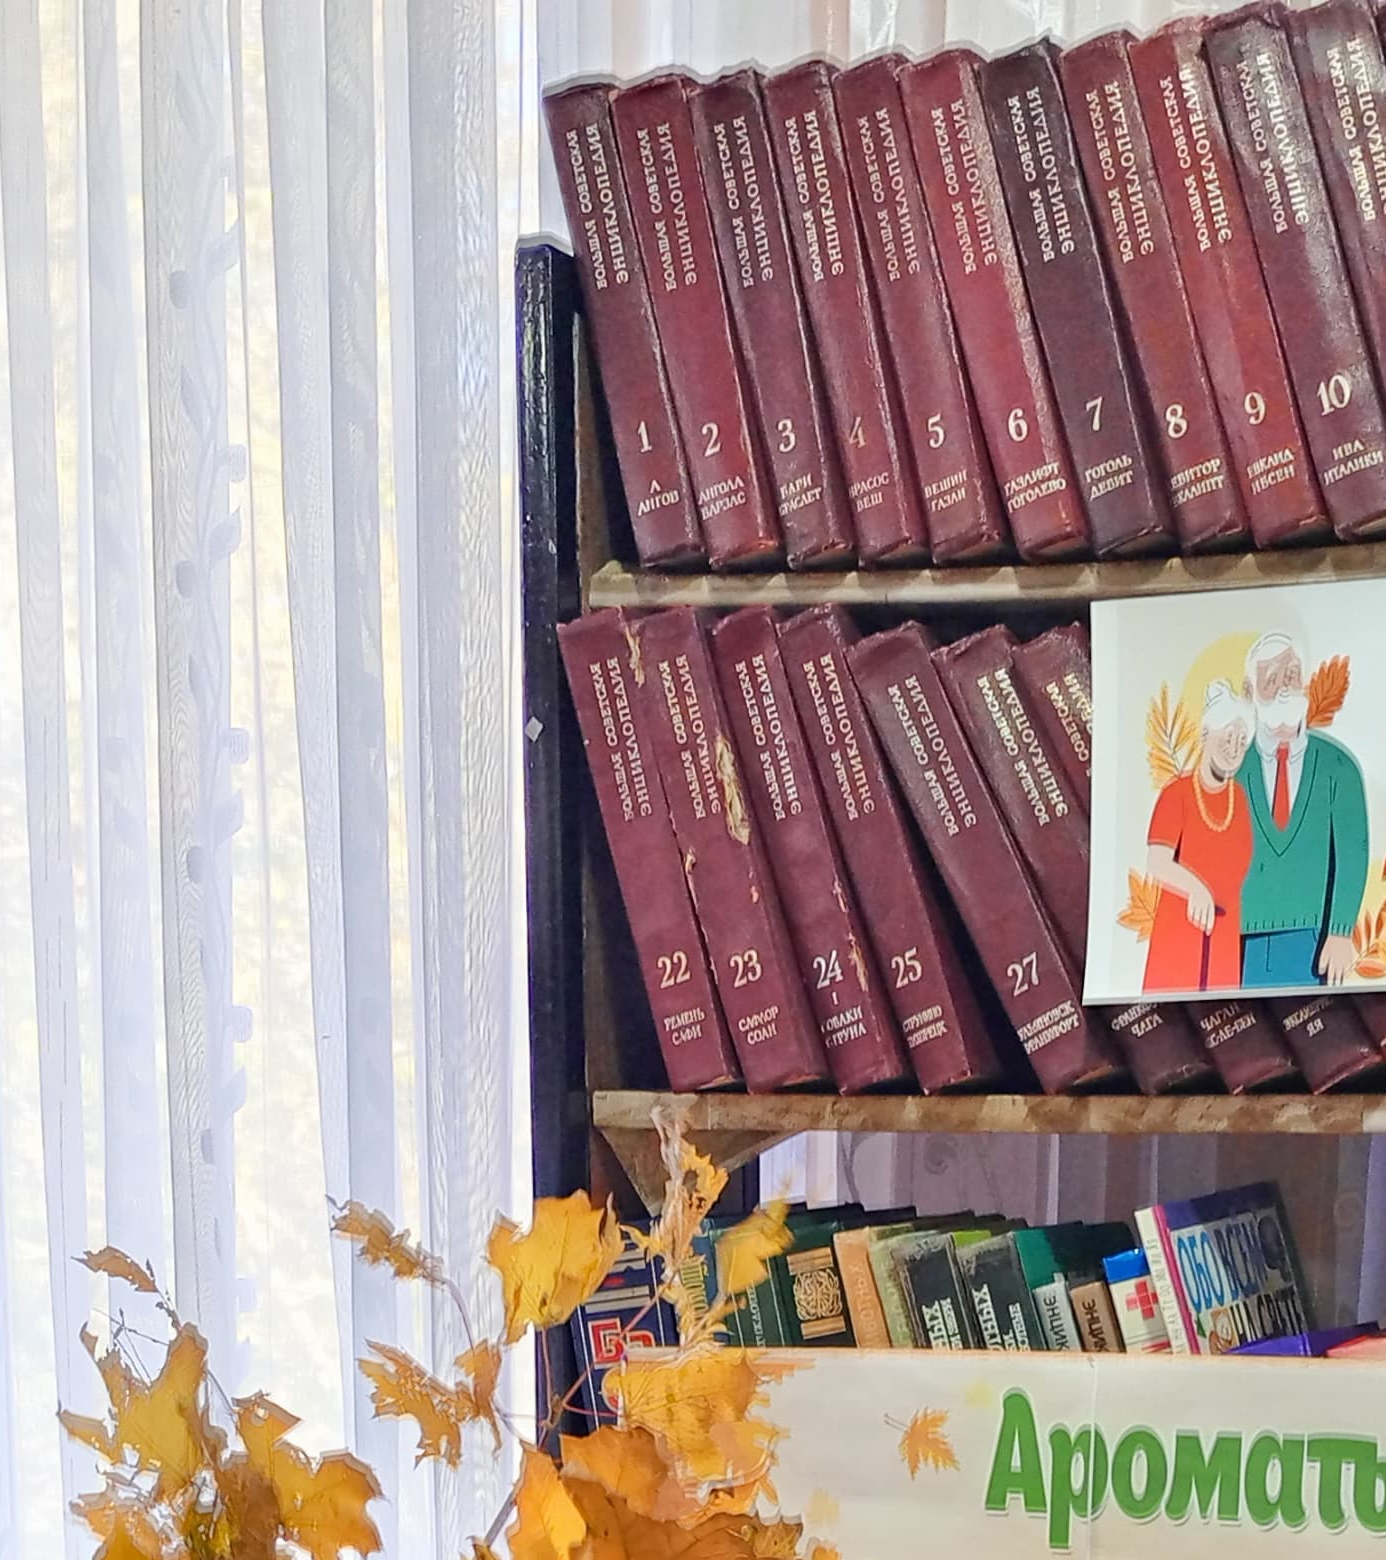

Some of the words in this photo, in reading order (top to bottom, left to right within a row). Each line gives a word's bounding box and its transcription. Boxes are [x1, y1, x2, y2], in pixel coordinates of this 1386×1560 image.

[1008, 95, 1036, 182] СОВЕТСКАЯ
[713, 123, 739, 210] СОВЕТСКАЯ
[1026, 86, 1075, 254] ЭНЦИКЛОПЕДИЯ
[733, 115, 773, 282] ЭНЦИКЛОПЕДИЯ
[1029, 188, 1055, 263] БОЛЬШАЯ
[732, 216, 754, 288] БОЛЬШАЯ
[1086, 397, 1104, 431] 7
[1244, 392, 1266, 425] 9
[1317, 374, 1351, 416] 10
[637, 421, 652, 452] 1
[701, 423, 721, 457] 2
[778, 419, 796, 452] 3
[848, 416, 866, 448] 4
[927, 413, 944, 448] 5
[1008, 408, 1028, 441] 6
[1165, 404, 1188, 439] 8
[887, 684, 928, 765] СОВЕТСКАЯ
[905, 675, 977, 828] ЭНЦИКЛОПЕДИЯ
[924, 769, 959, 837] БОЛЬШАЯ
[657, 951, 691, 989] 22
[730, 950, 762, 988] 23
[813, 950, 843, 989] 24
[891, 947, 922, 988] 25
[1007, 952, 1039, 997] 27
